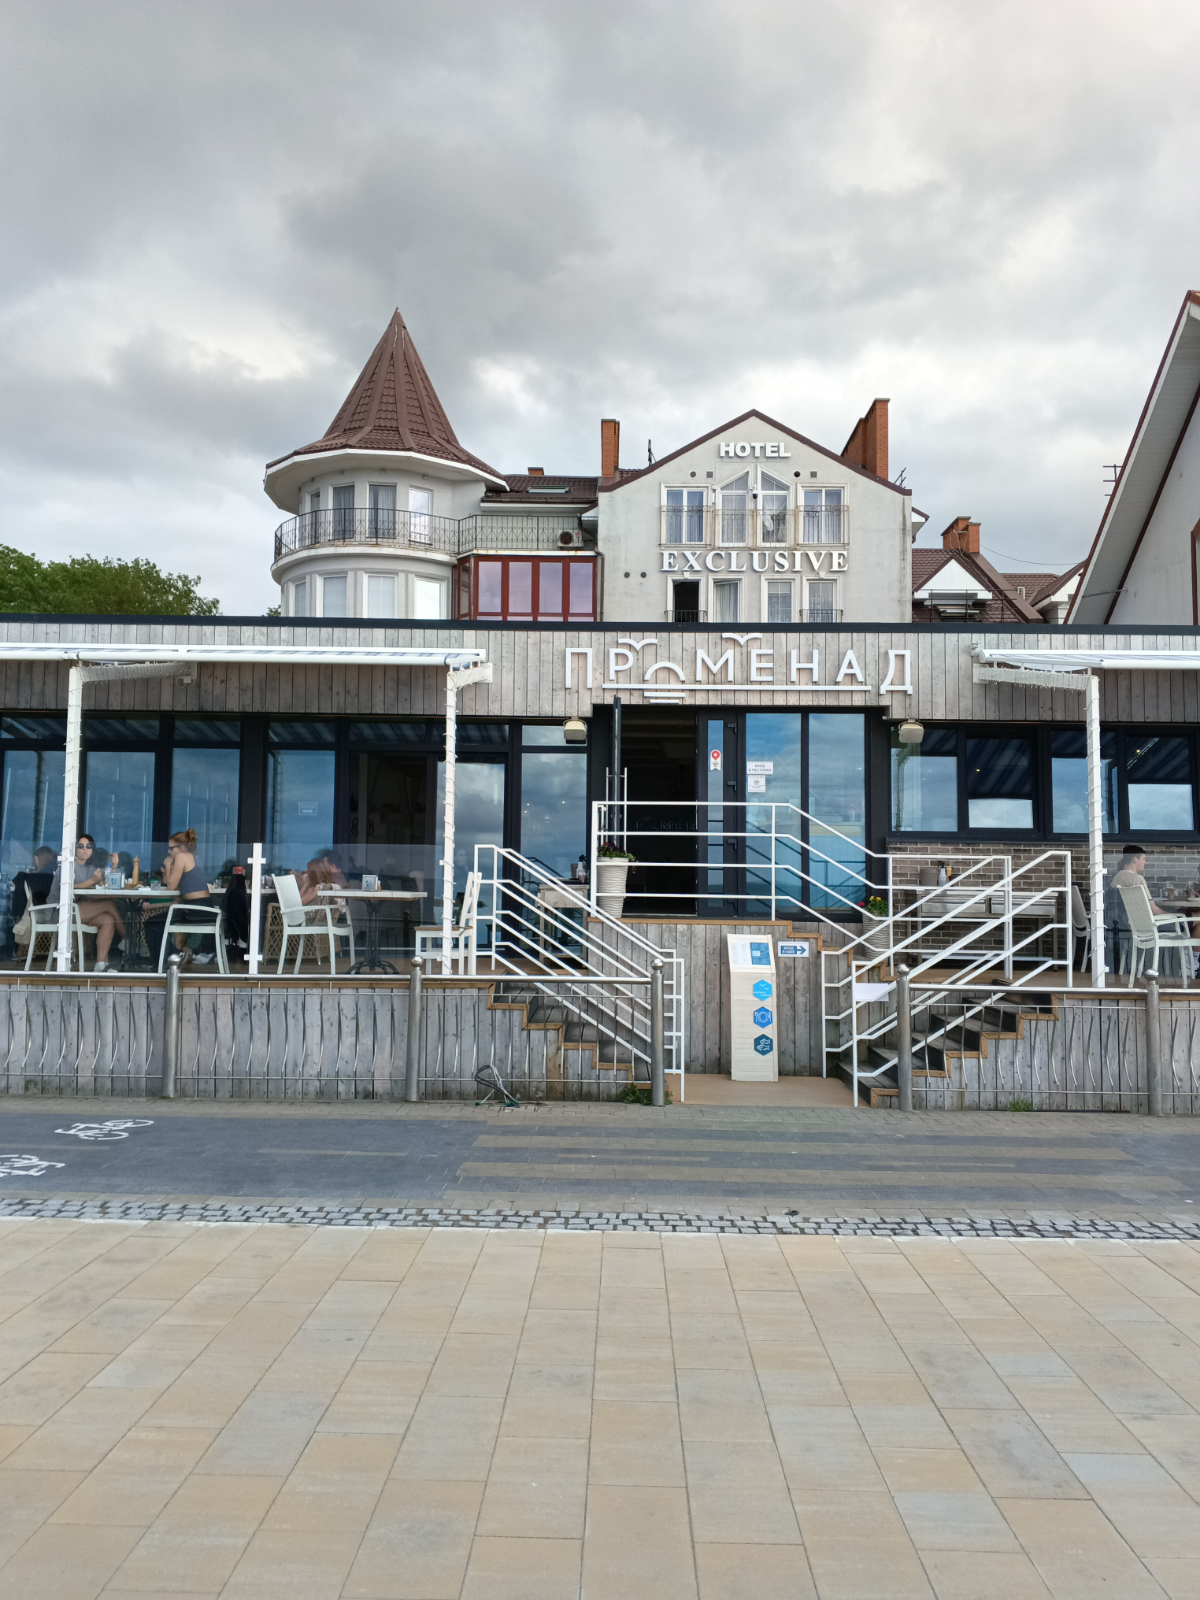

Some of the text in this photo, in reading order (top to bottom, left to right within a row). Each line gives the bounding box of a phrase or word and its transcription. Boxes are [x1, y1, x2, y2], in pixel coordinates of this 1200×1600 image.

[719, 441, 791, 458] HOTEL
[660, 550, 849, 572] EXCLUSIVE
[565, 647, 913, 696] ПРОМЕНАД
